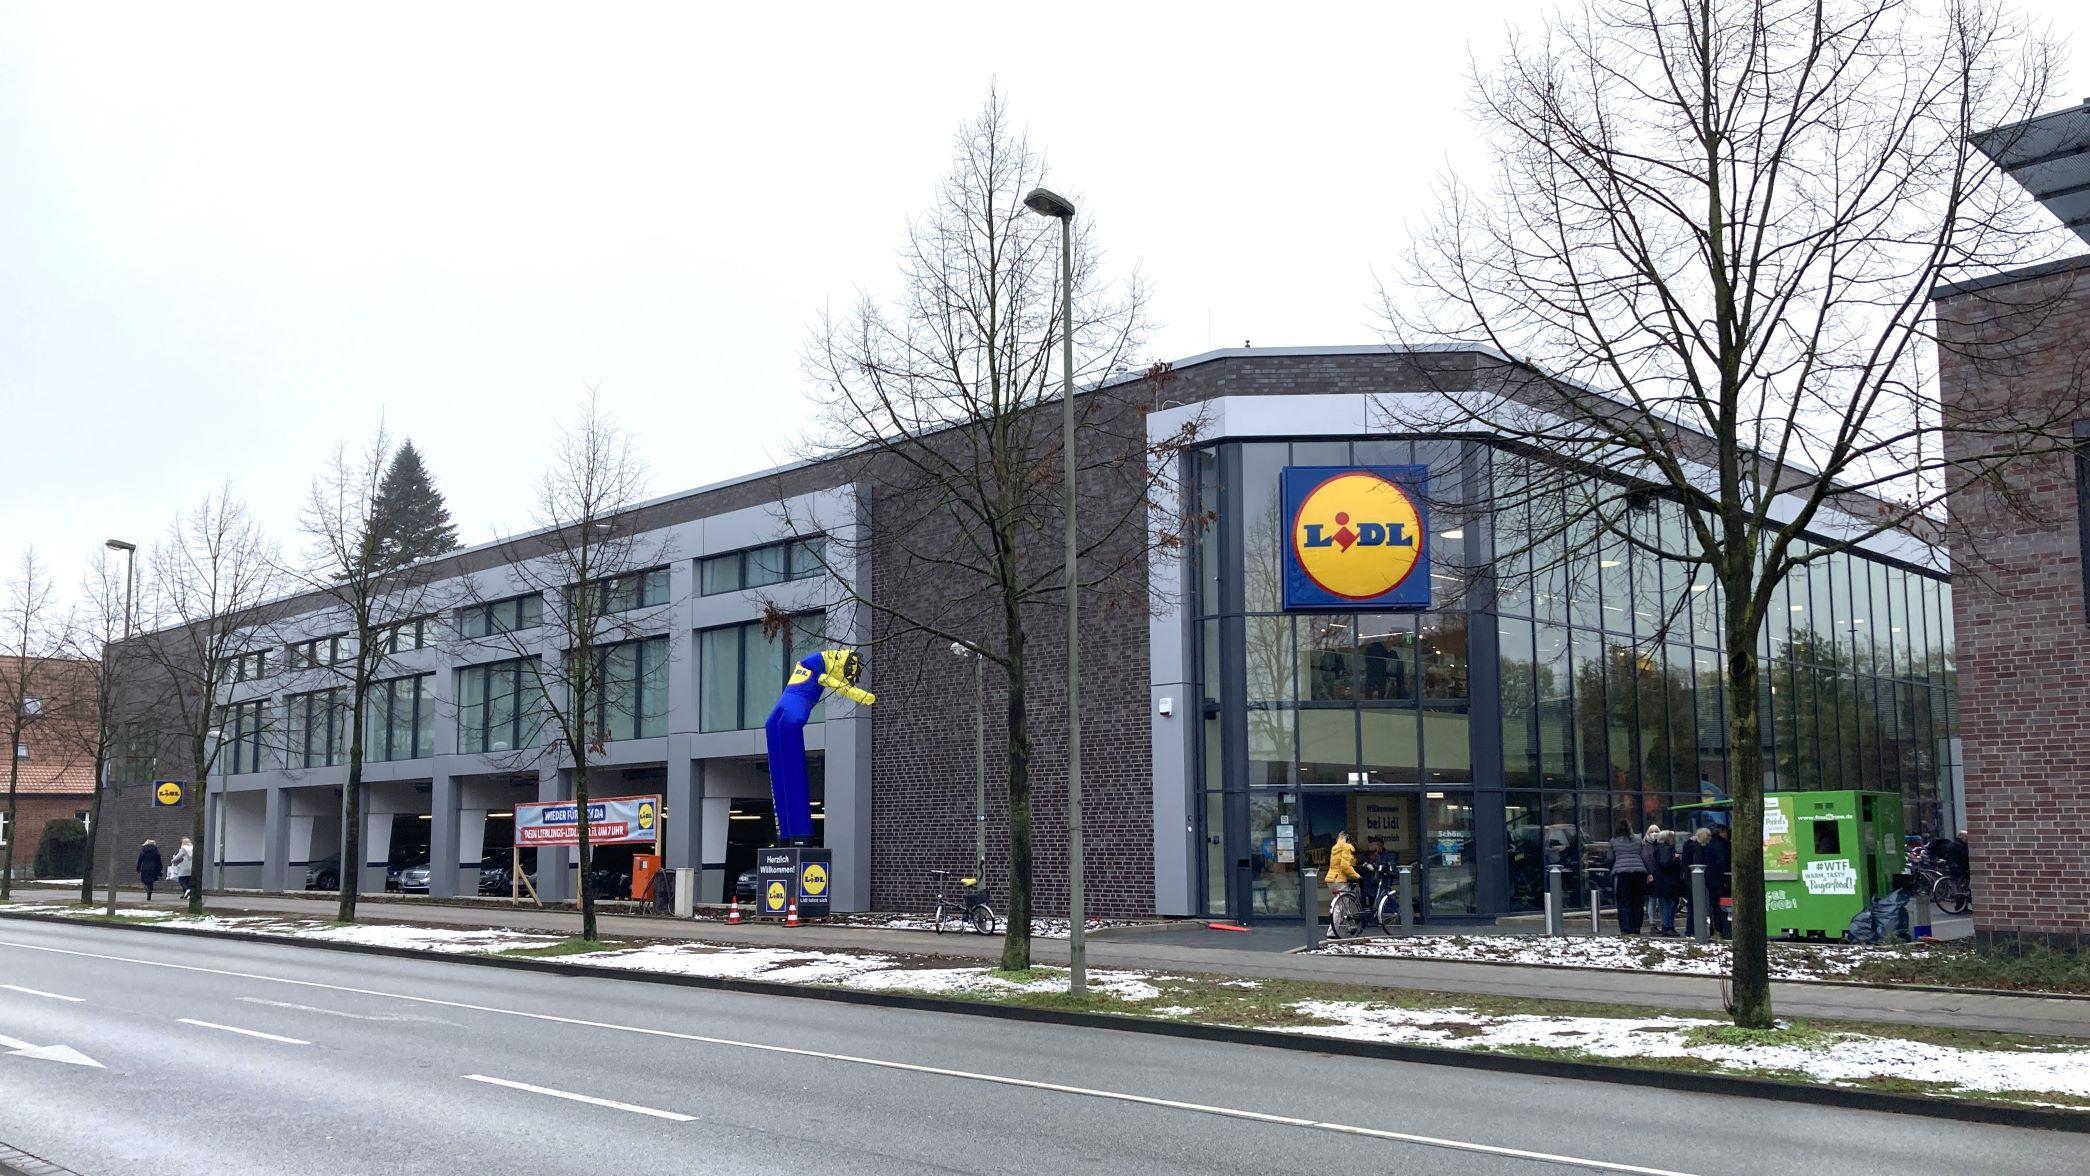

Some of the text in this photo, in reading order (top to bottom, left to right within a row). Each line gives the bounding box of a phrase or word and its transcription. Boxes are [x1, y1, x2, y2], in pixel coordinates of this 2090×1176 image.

[1304, 512, 1413, 553] LIDL
[158, 789, 180, 797] LIDL
[1367, 816, 1400, 829] bei Lidl
[612, 825, 624, 835] UHR
[766, 855, 789, 864] Herzlich
[760, 865, 795, 874] Willkommen!
[1816, 861, 1848, 871] #WTF
[804, 873, 825, 884] LIDL
[769, 890, 784, 899] LIDL
